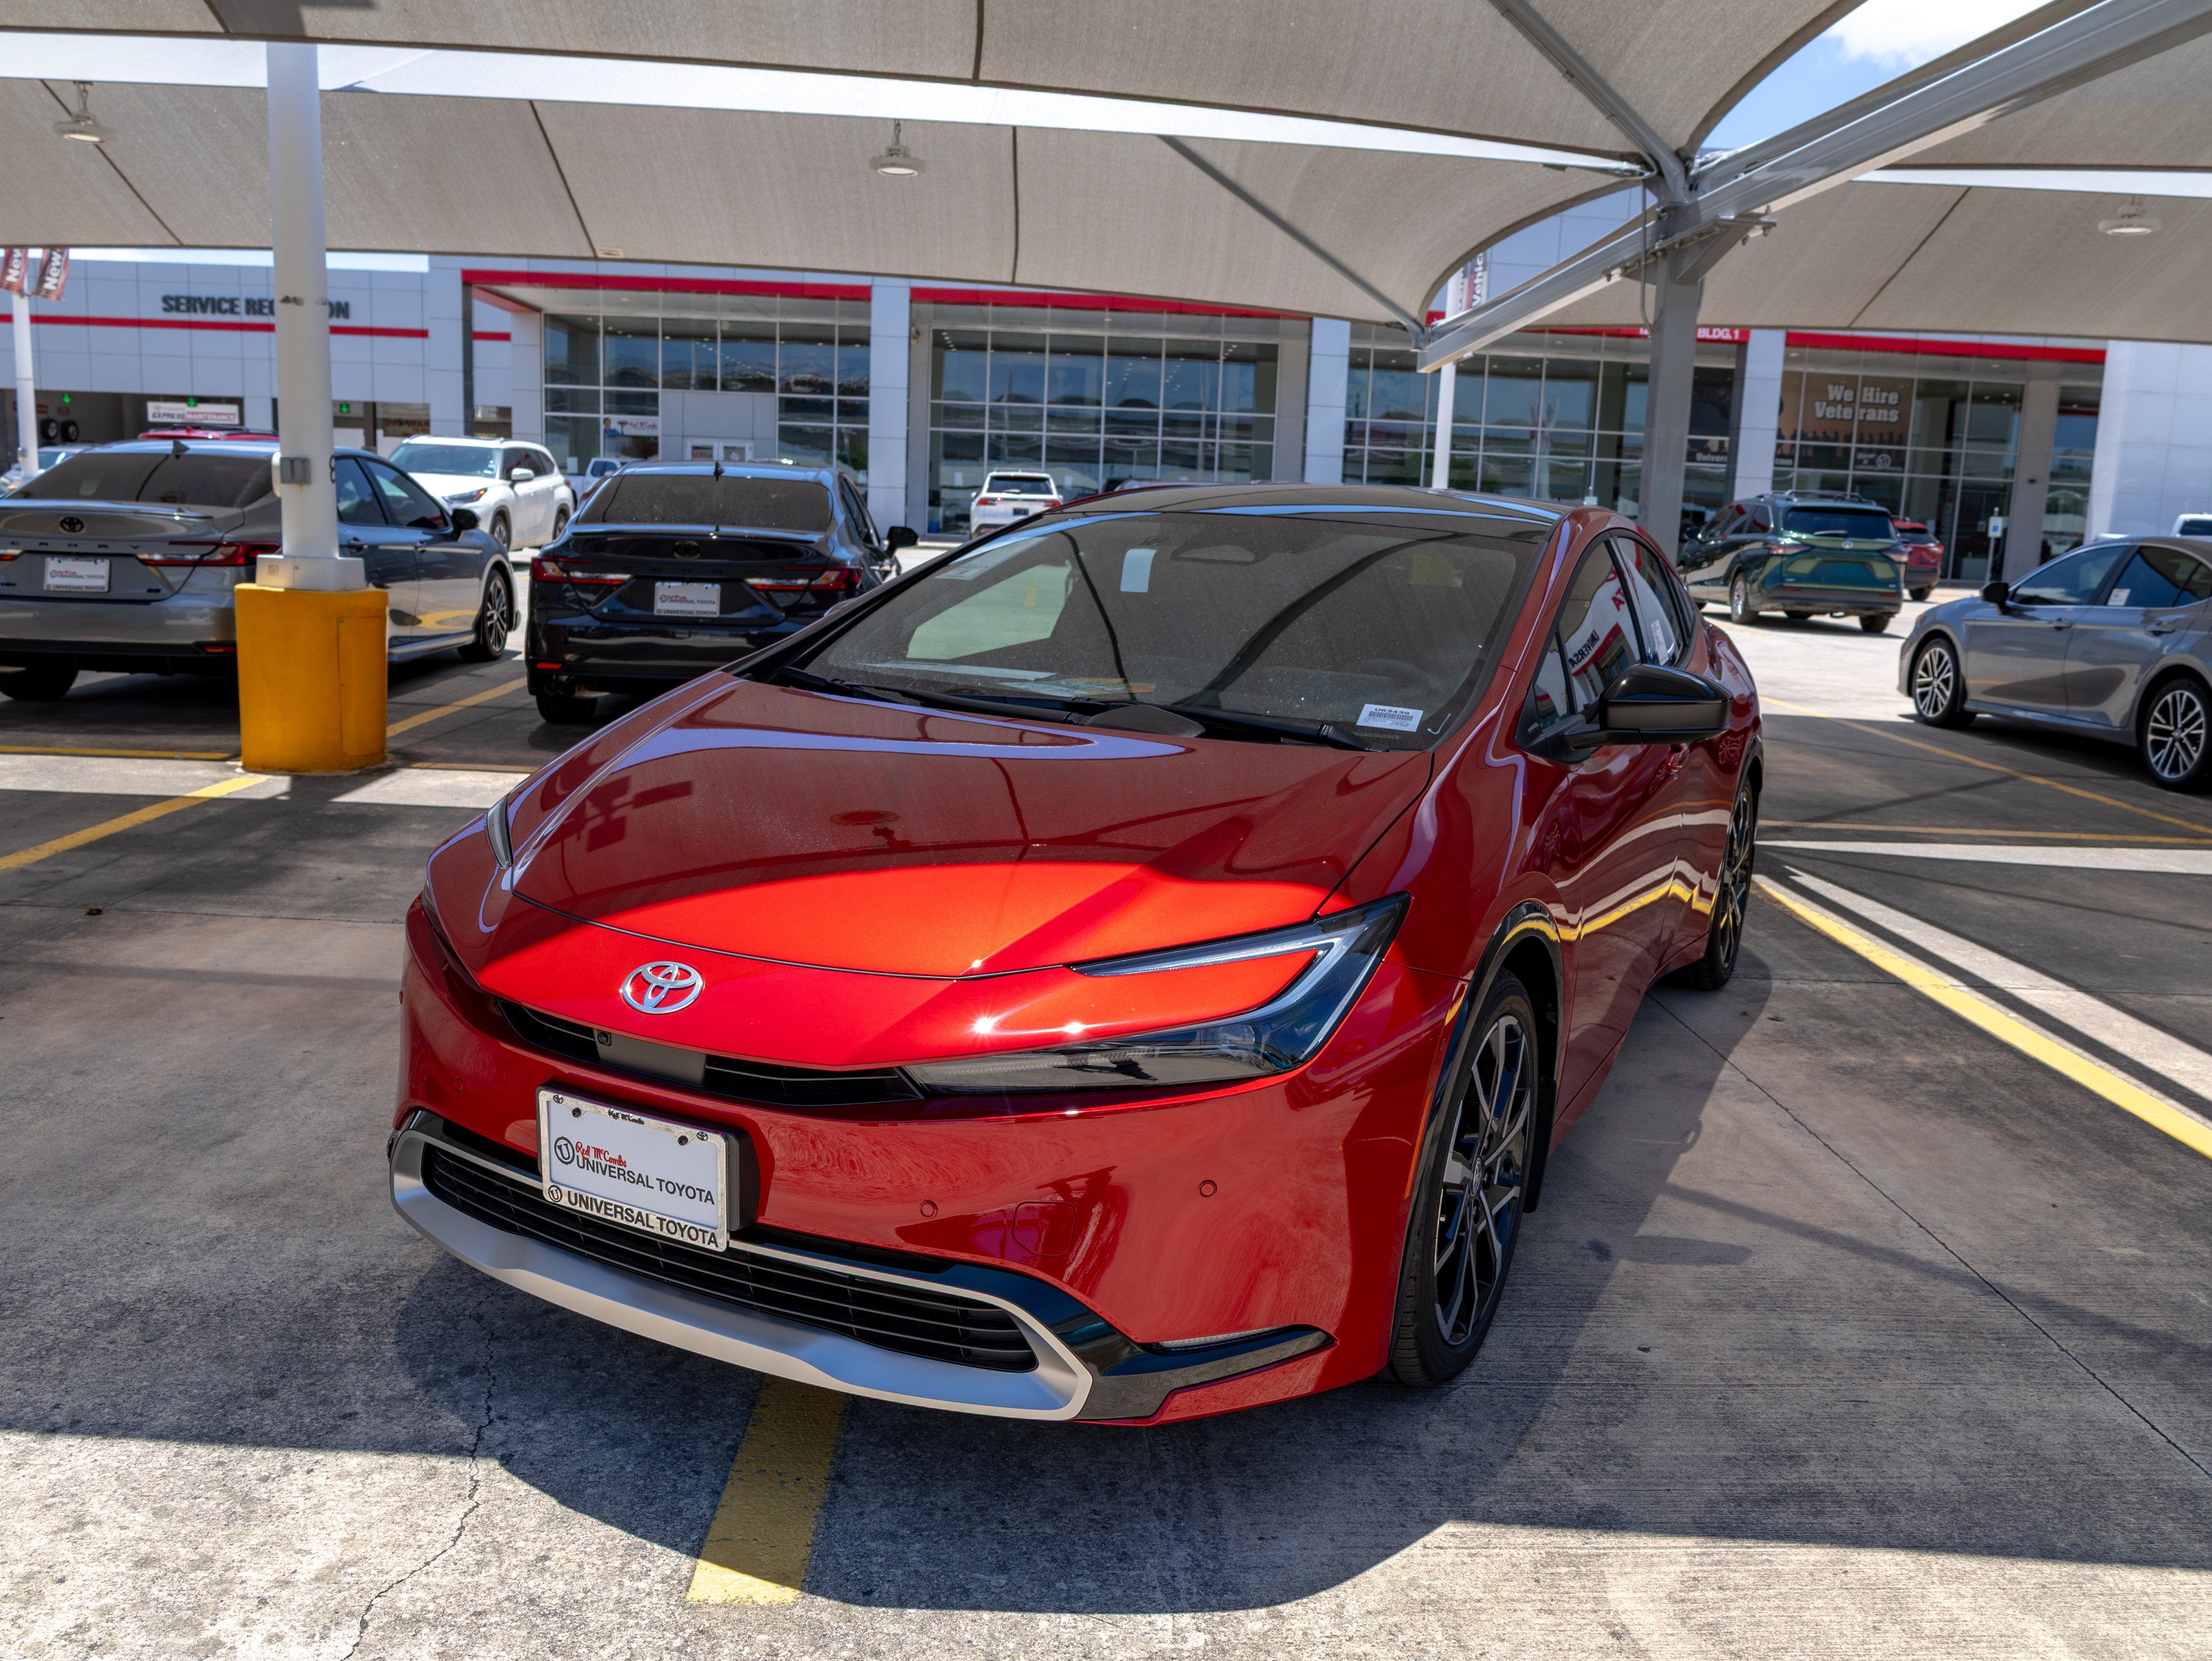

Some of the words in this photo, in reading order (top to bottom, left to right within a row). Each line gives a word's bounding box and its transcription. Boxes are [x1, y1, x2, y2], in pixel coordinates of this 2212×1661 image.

[43, 250, 62, 291] New
[161, 294, 241, 315] SERVICE
[1827, 384, 1855, 402] We
[1861, 386, 1900, 405] Hire
[1815, 401, 1900, 422] Veterans
[575, 1141, 591, 1160] Red
[592, 1146, 627, 1168] McCombs
[576, 1155, 654, 1189] UNIVERSAL
[656, 1178, 715, 1205] TOYOTA
[568, 1190, 655, 1229] UNIVERSAL
[656, 1216, 719, 1248] TOYOTA
